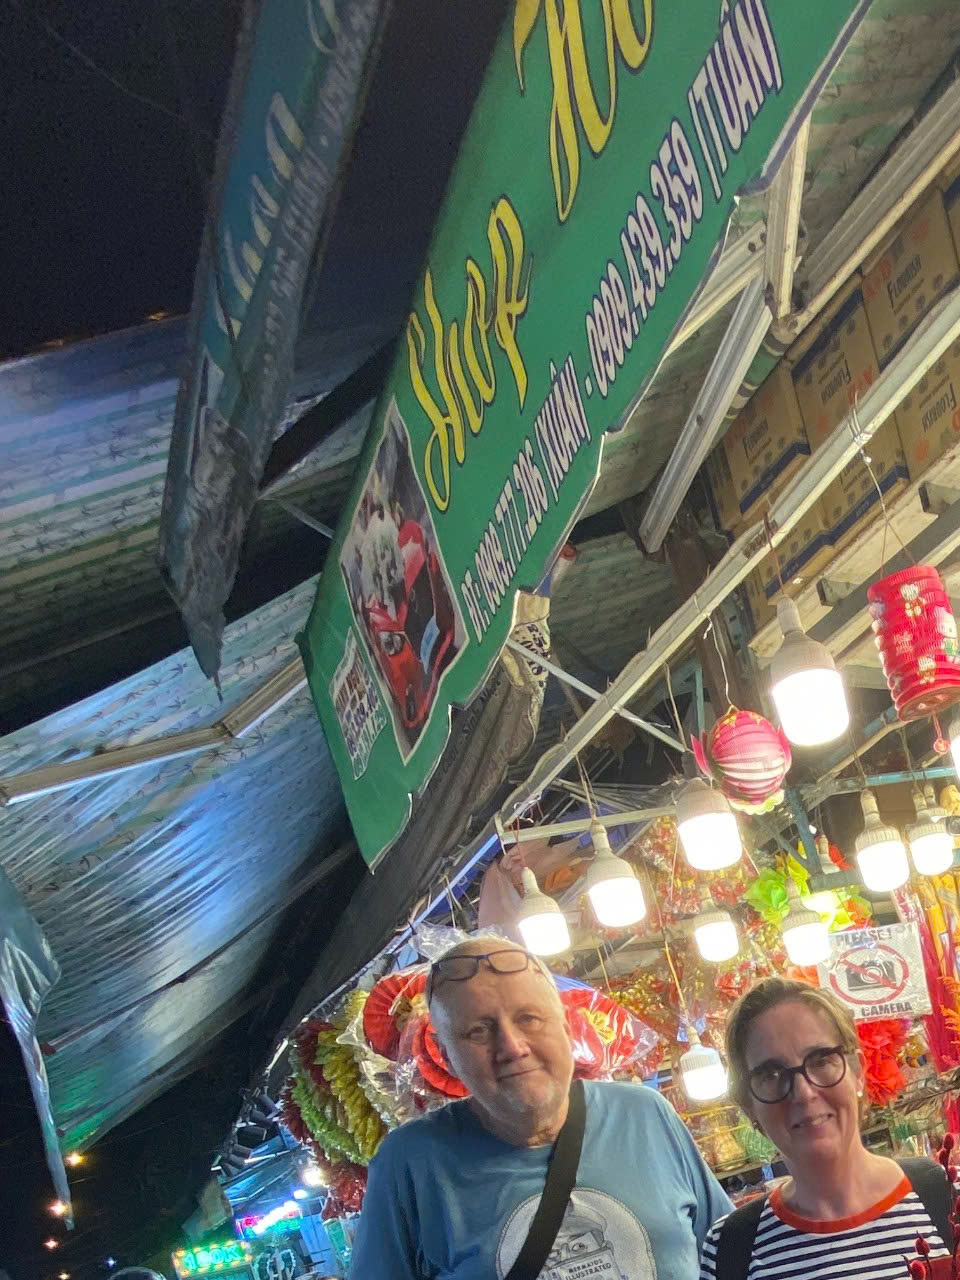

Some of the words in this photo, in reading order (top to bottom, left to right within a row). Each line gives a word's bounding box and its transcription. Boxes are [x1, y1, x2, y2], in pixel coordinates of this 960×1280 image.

[586, 116, 704, 398] 0909.439.359
[861, 1001, 914, 1017] CAMERA
[565, 1262, 612, 1280] ILLUSTRATED
